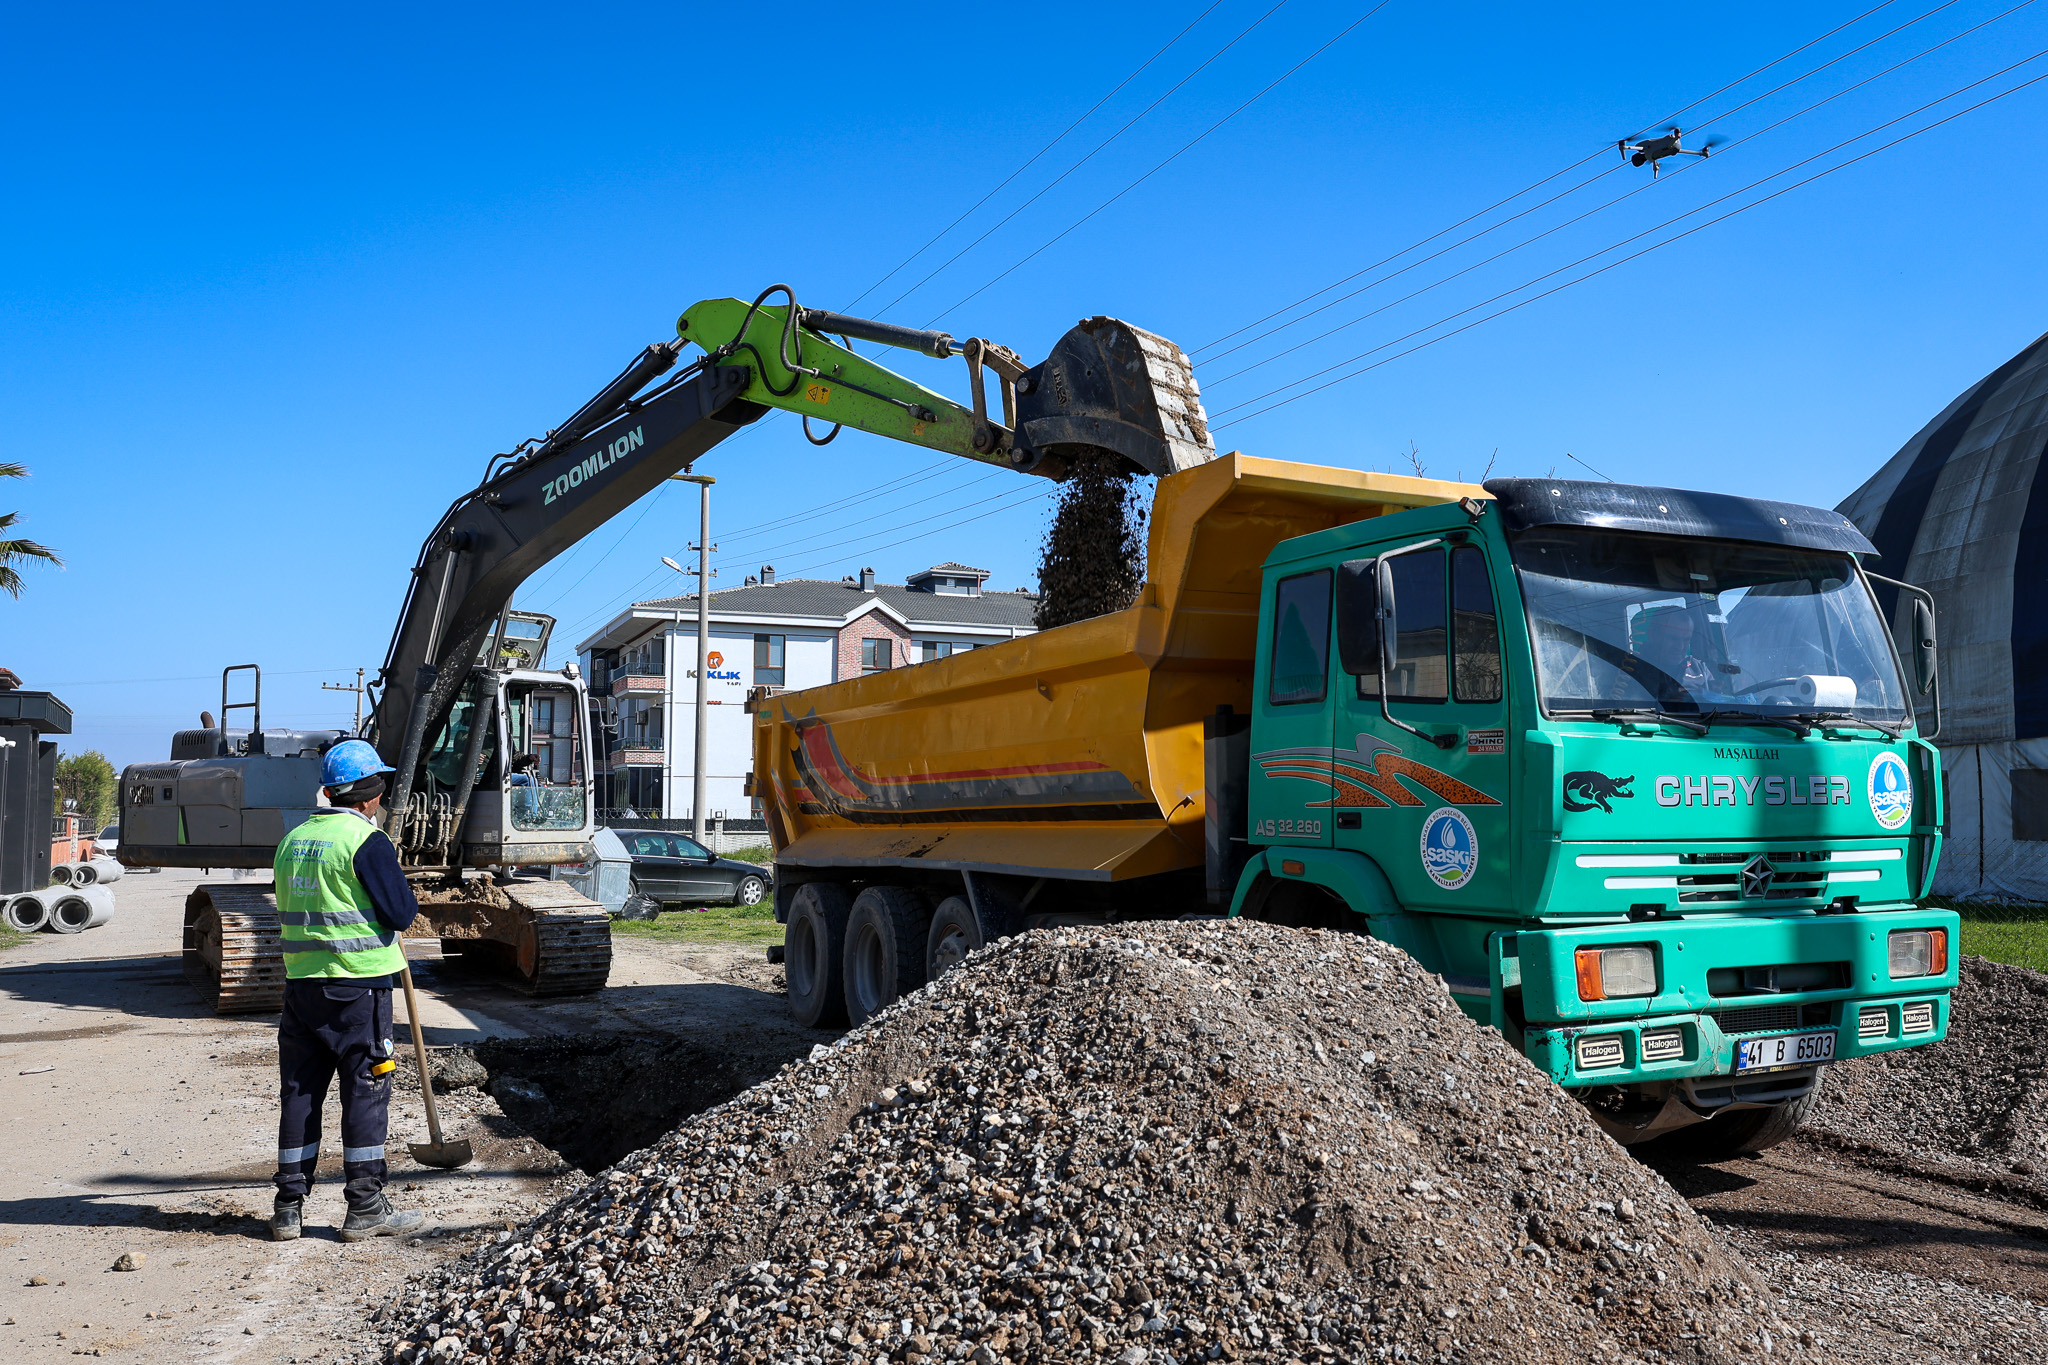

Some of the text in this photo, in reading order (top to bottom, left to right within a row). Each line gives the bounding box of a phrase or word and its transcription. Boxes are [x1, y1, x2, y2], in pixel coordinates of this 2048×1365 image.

[541, 425, 644, 506] ZOOMLION
[1713, 747, 1779, 762] MAŞALLAH
[1654, 775, 1851, 807] CHRYSLER
[1255, 819, 1321, 837] AS 32.260
[1860, 1018, 1884, 1027] Halogen
[1905, 1013, 1928, 1023] Halogen
[1585, 1046, 1617, 1056] Halogen
[1648, 1039, 1678, 1049] Halogen
[1748, 1041, 1763, 1065] 41
[1776, 1040, 1785, 1062] B
[1797, 1035, 1833, 1060] 6503
